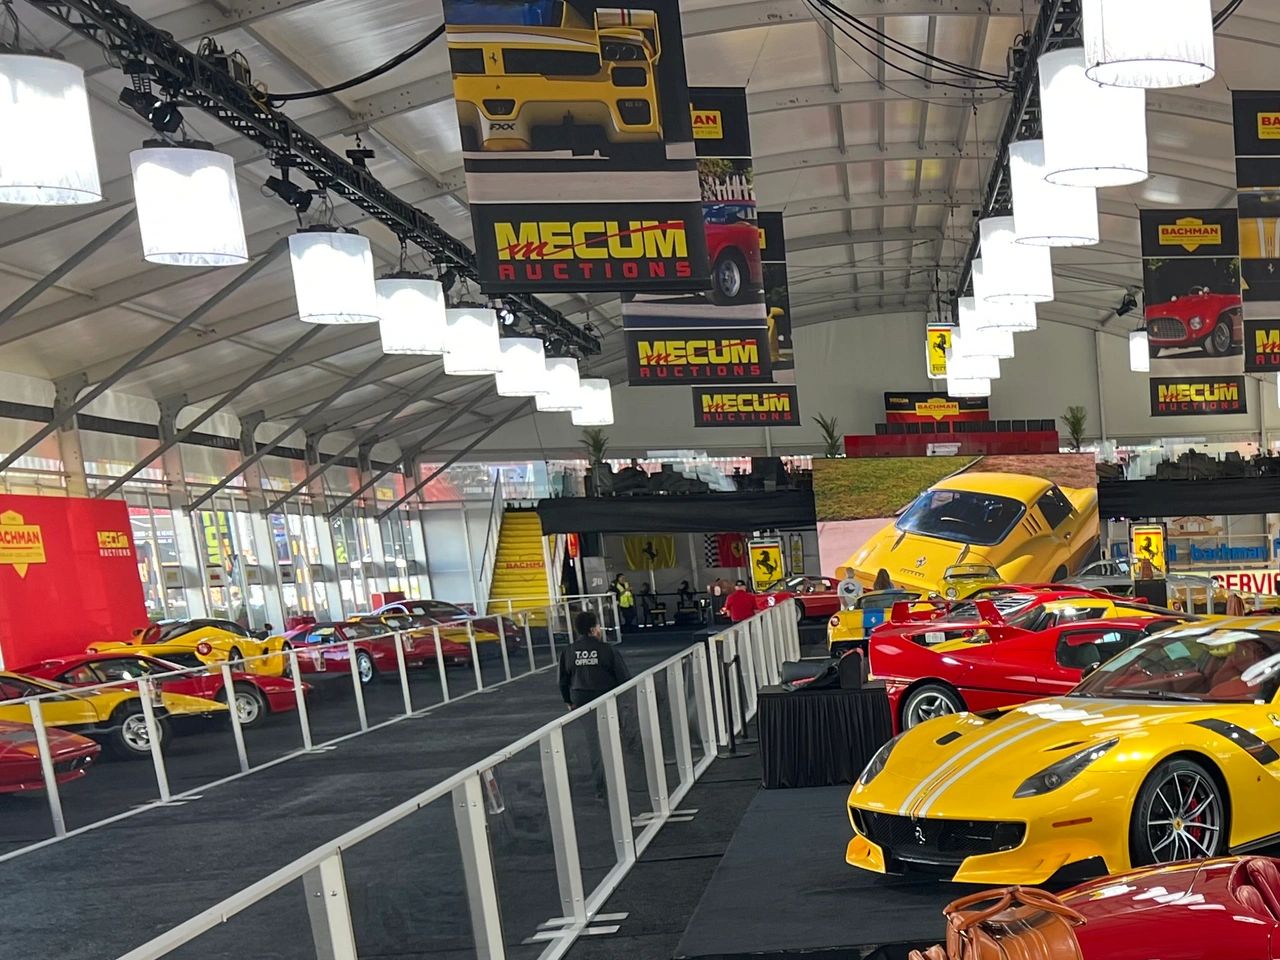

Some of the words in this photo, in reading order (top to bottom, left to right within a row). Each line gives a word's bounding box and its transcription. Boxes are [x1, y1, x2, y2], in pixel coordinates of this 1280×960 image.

[489, 122, 516, 131] FXX
[1161, 227, 1218, 235] BACHMAN
[494, 220, 689, 260] MECUM
[498, 261, 692, 280] AUCTIONS
[637, 339, 759, 366] MECUM
[640, 365, 761, 378] AUCTIONS
[1158, 382, 1238, 403] MECUM
[701, 393, 790, 413] MECUM
[1158, 401, 1239, 411] AUCTIONS
[703, 412, 792, 421] AUCTIONS
[0, 530, 41, 545] ACHMAN
[575, 658, 598, 666] OFFICER
